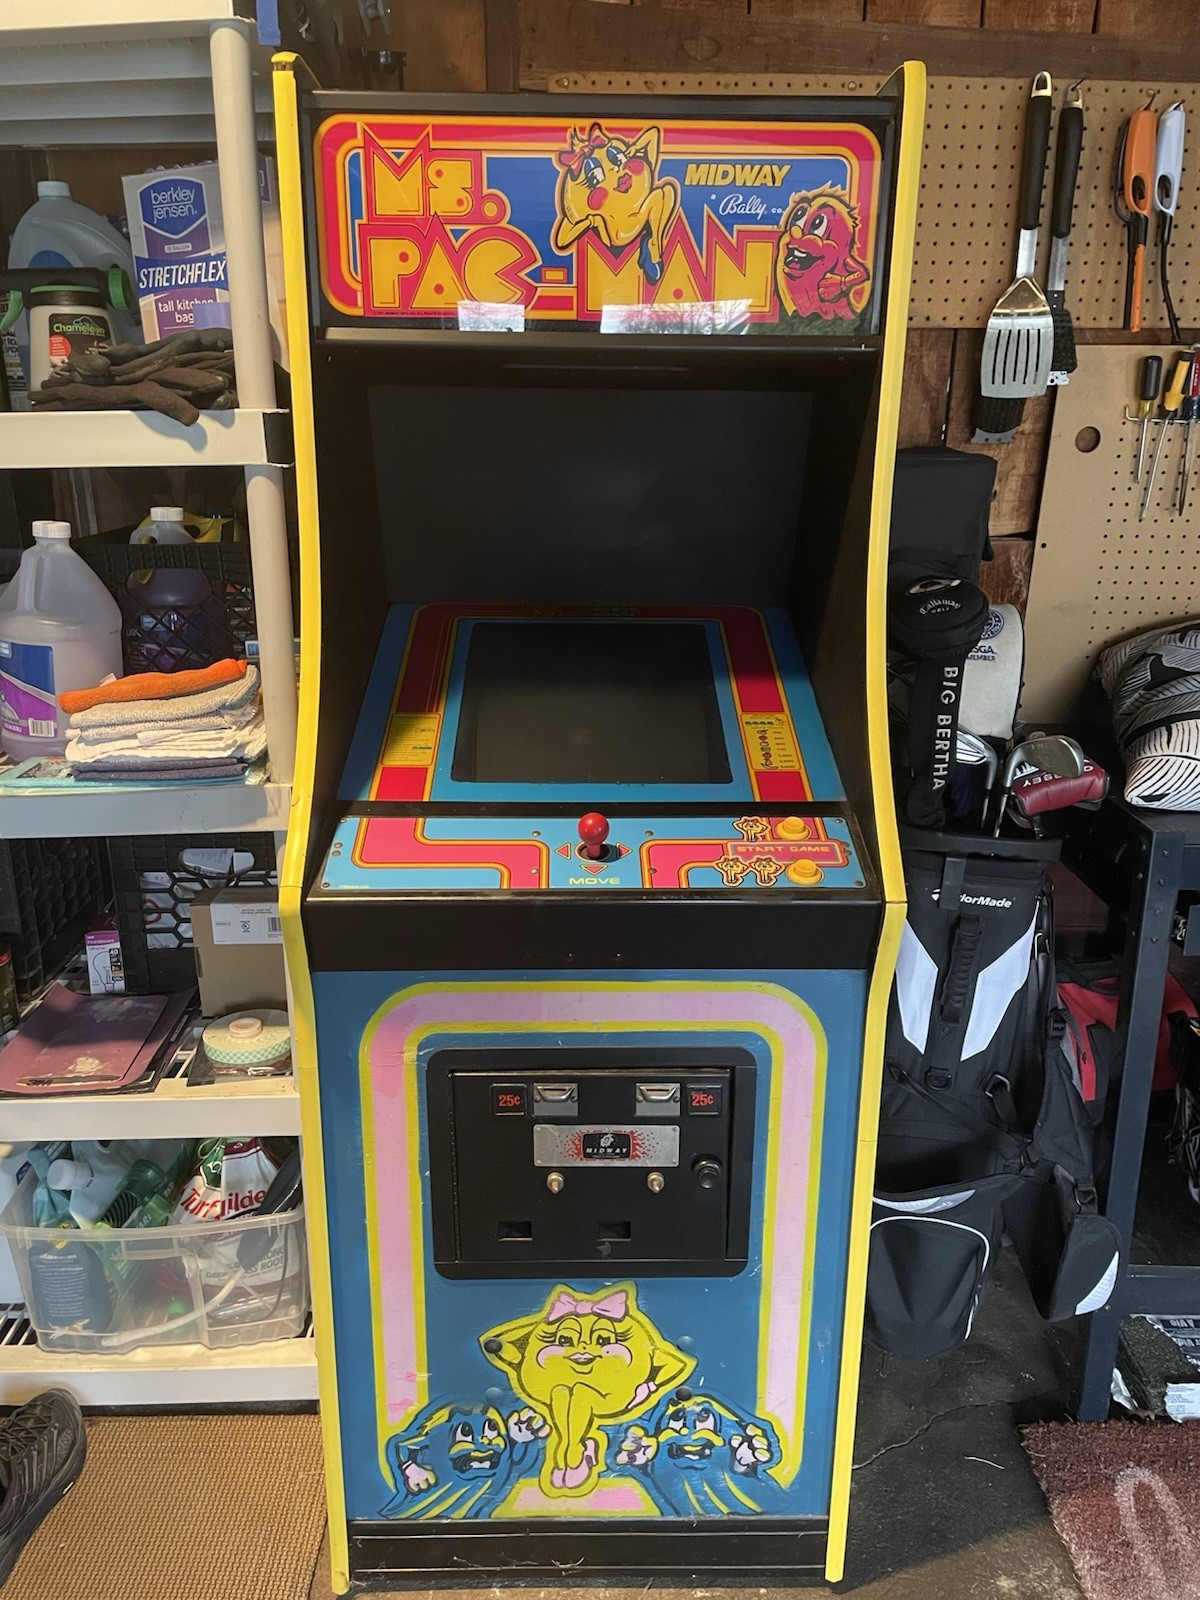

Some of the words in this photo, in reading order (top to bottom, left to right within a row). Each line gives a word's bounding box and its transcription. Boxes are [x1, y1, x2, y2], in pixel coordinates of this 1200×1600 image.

[684, 163, 791, 187] MIDWAY
[151, 186, 195, 204] berkley
[152, 203, 197, 223] jensen
[719, 193, 767, 220] Bally
[139, 260, 227, 289] STRETCHFLEX
[362, 222, 780, 318] PAC-MAN
[158, 300, 175, 312] tall
[176, 297, 214, 311] kitc
[175, 311, 195, 323] bag
[919, 598, 962, 615] Callaway
[972, 645, 996, 654] SGA
[940, 666, 959, 705] BIG
[931, 714, 952, 791] BERTHA
[789, 845, 830, 853] GAME
[569, 877, 620, 885] MOVE
[959, 893, 1013, 908] lorMade
[260, 1257, 285, 1271] ROOT
